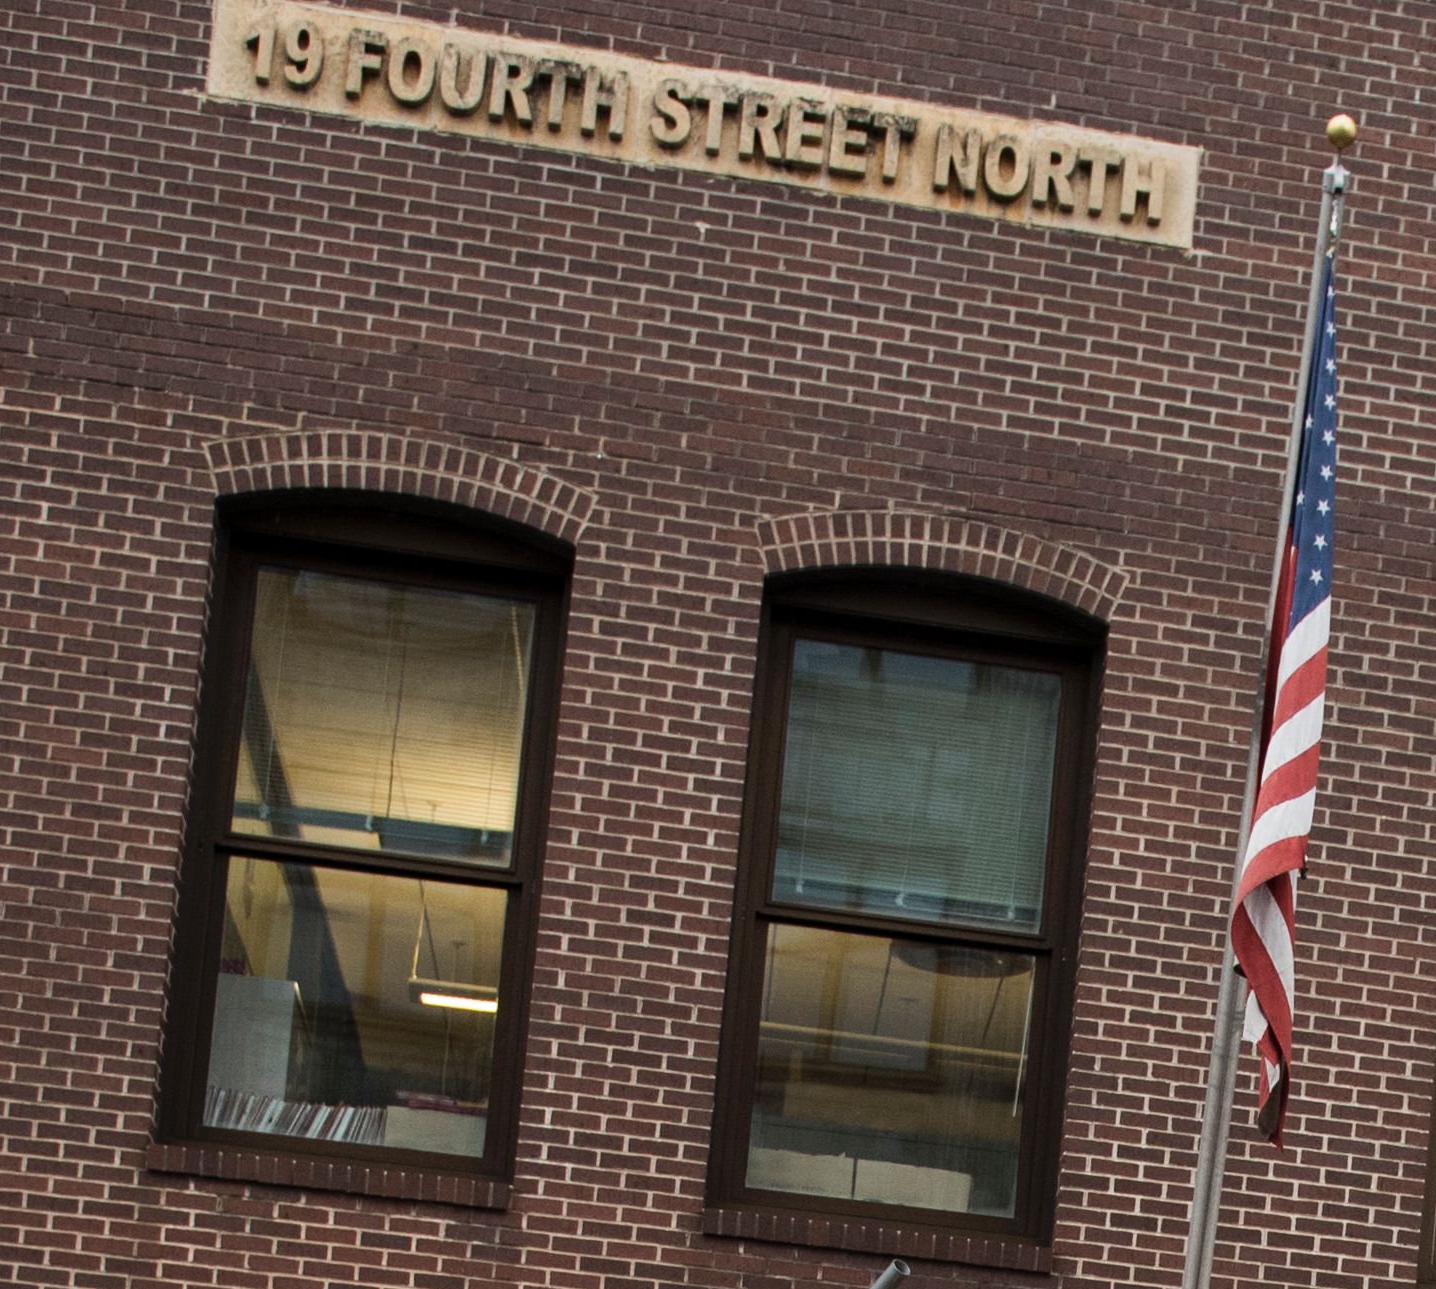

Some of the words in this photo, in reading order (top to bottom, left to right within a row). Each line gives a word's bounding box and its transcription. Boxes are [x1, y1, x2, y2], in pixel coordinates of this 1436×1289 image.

[244, 19, 325, 91] 19
[344, 30, 630, 142] FOURTH
[648, 77, 919, 184] STREET
[932, 122, 1165, 228] NORTH
